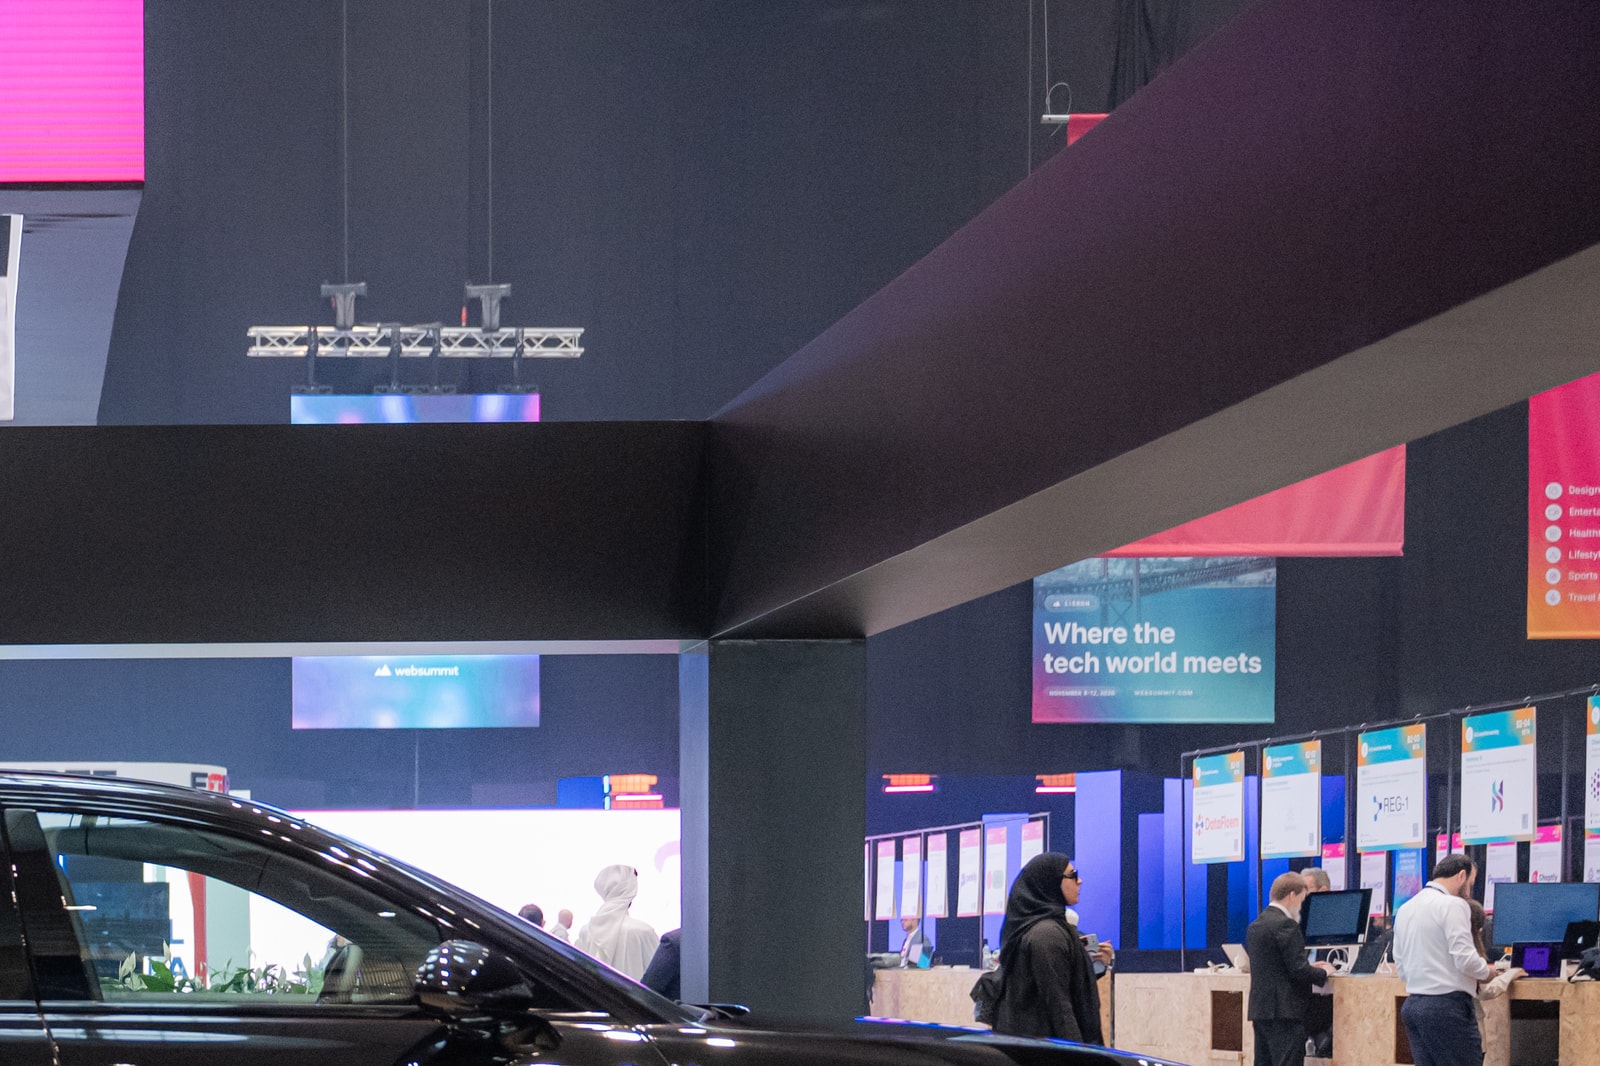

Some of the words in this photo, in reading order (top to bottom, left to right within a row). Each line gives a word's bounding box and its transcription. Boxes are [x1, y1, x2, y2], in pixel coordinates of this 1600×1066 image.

[1568, 571, 1598, 581] Sports
[1569, 592, 1596, 602] Travel
[1044, 622, 1128, 644] Where
[1133, 622, 1175, 644] the
[1043, 651, 1100, 674] tech
[1105, 651, 1177, 674] world
[1183, 652, 1262, 674] meets
[394, 664, 460, 677] websummit
